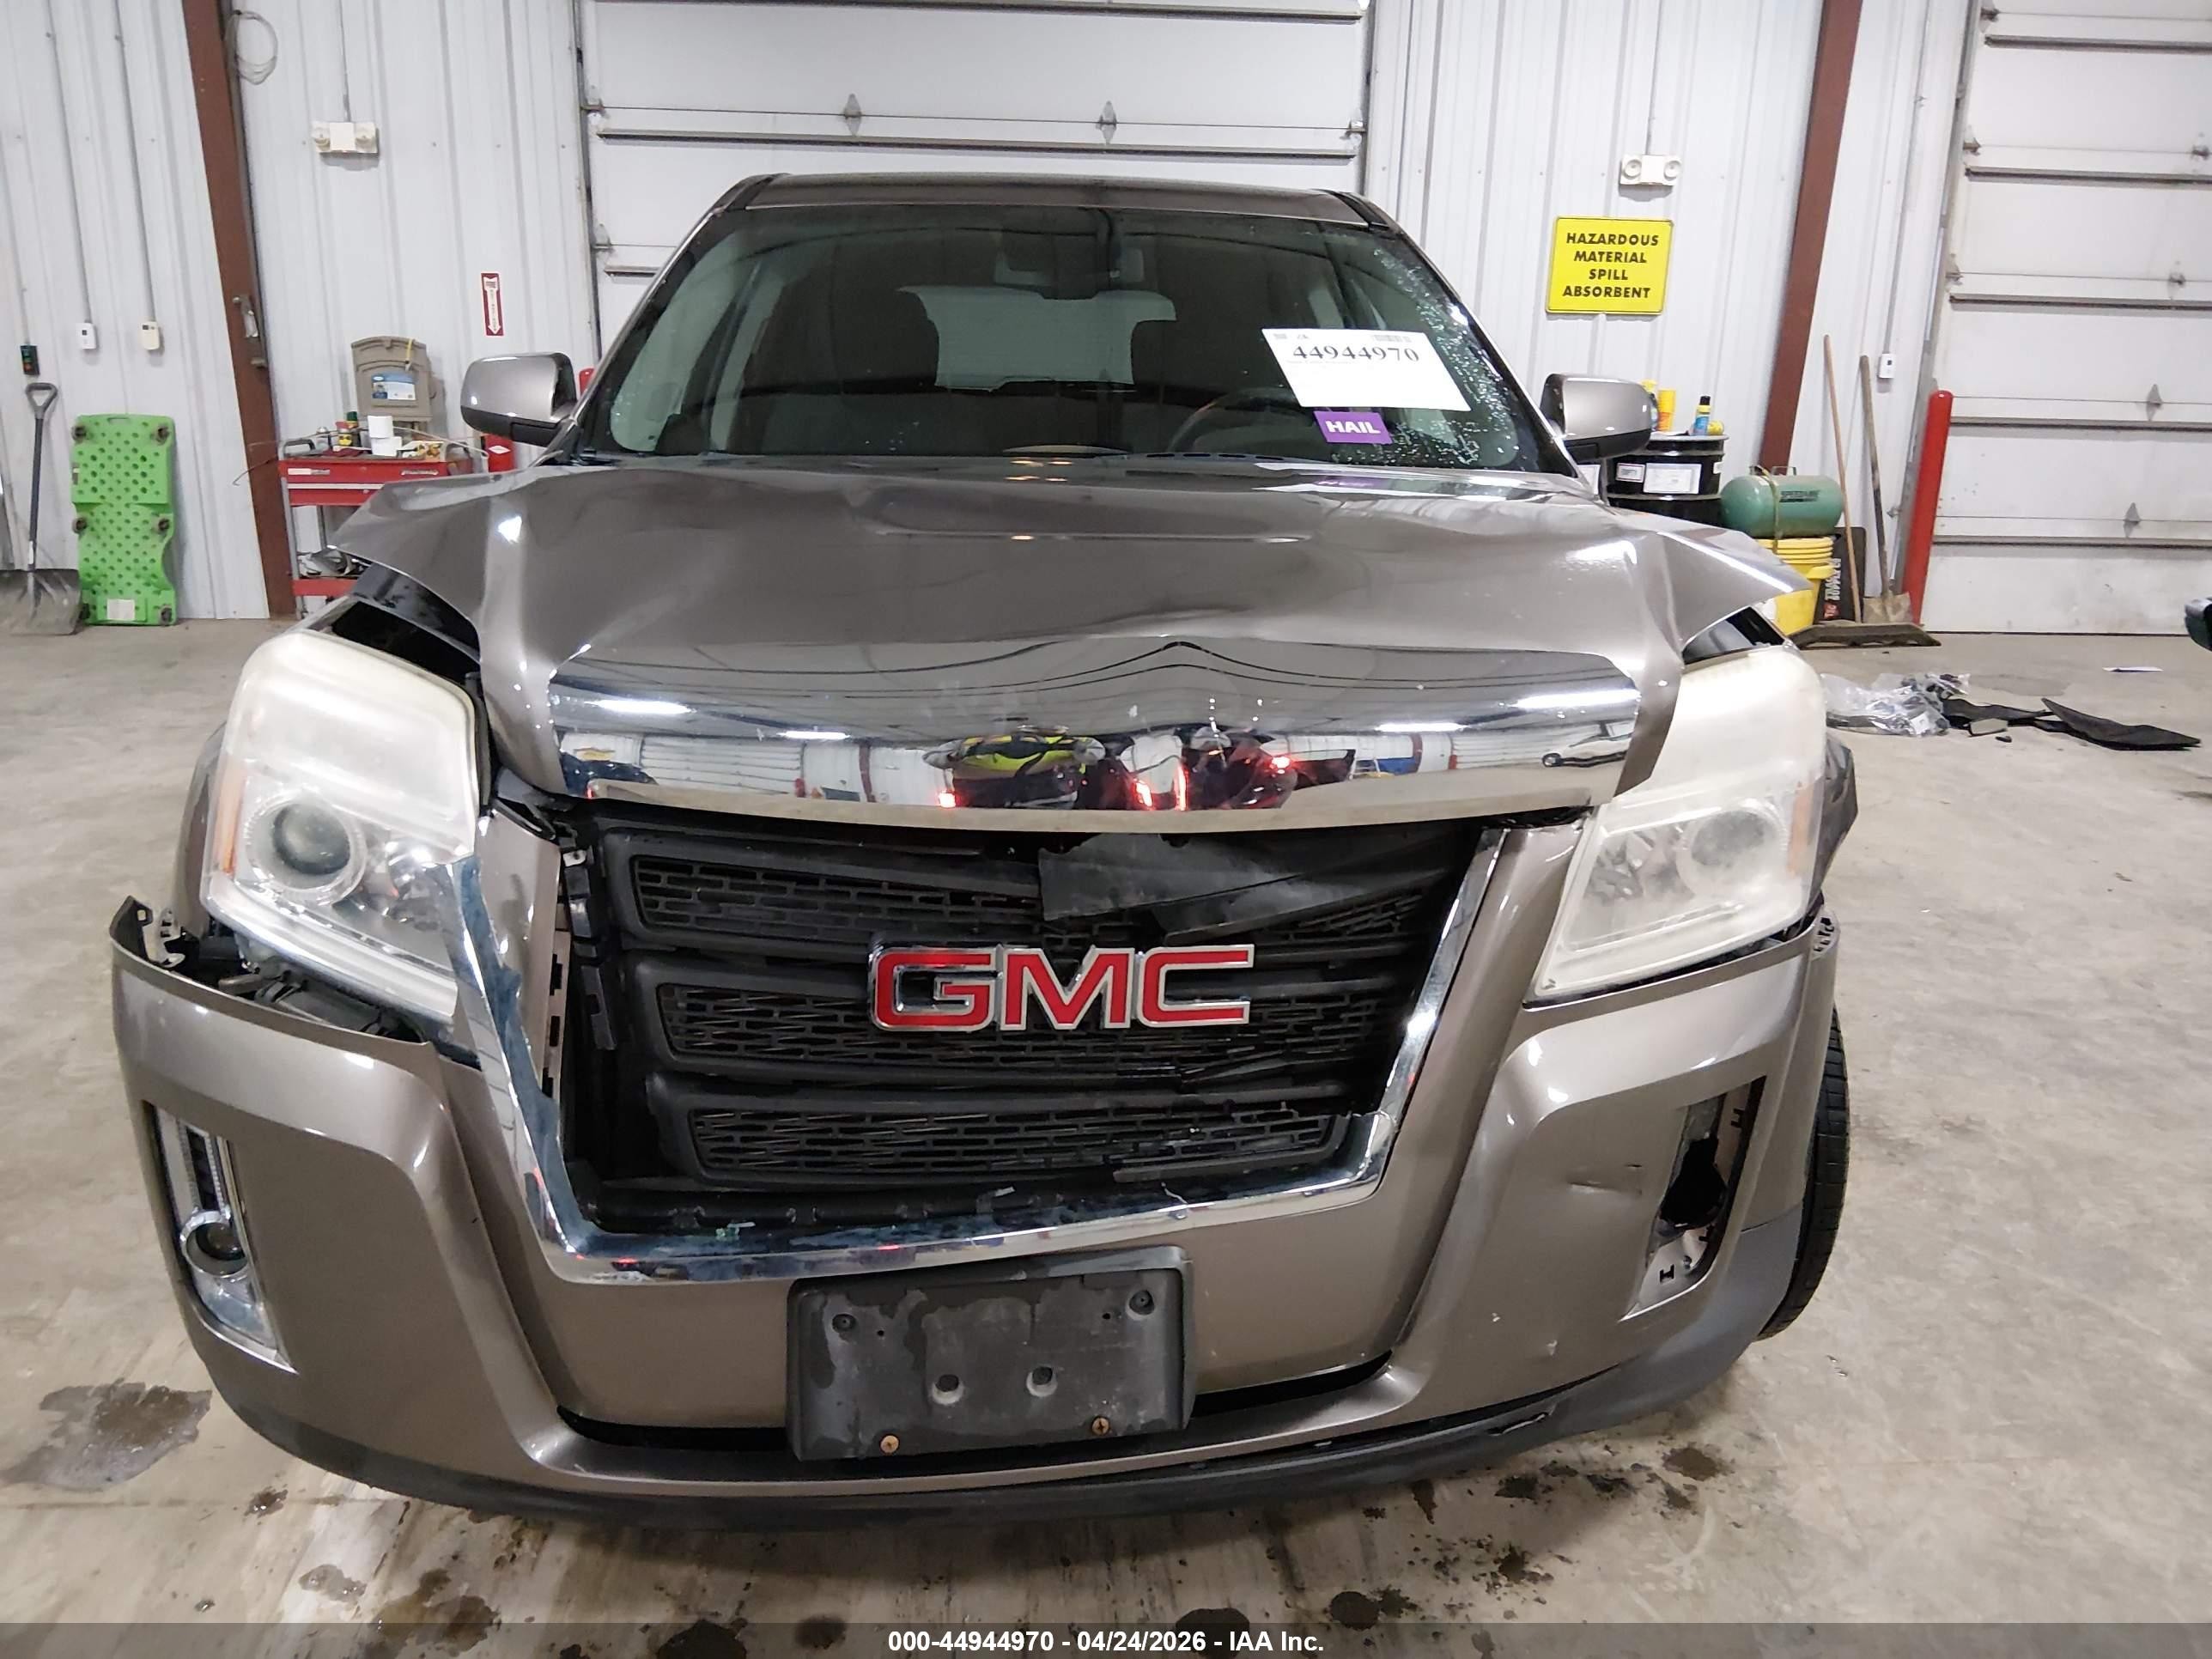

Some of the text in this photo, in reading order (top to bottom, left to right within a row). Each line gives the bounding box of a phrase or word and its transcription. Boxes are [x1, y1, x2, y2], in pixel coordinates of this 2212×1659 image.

[1566, 233, 1659, 246] HAZARDOUS
[1573, 250, 1647, 264] MATERIAL
[1589, 268, 1628, 281] SPILL
[1562, 285, 1650, 299] ABSORBENT
[1292, 345, 1419, 362] 44944970
[1325, 421, 1382, 434] HAIL
[868, 944, 1255, 1032] GMC
